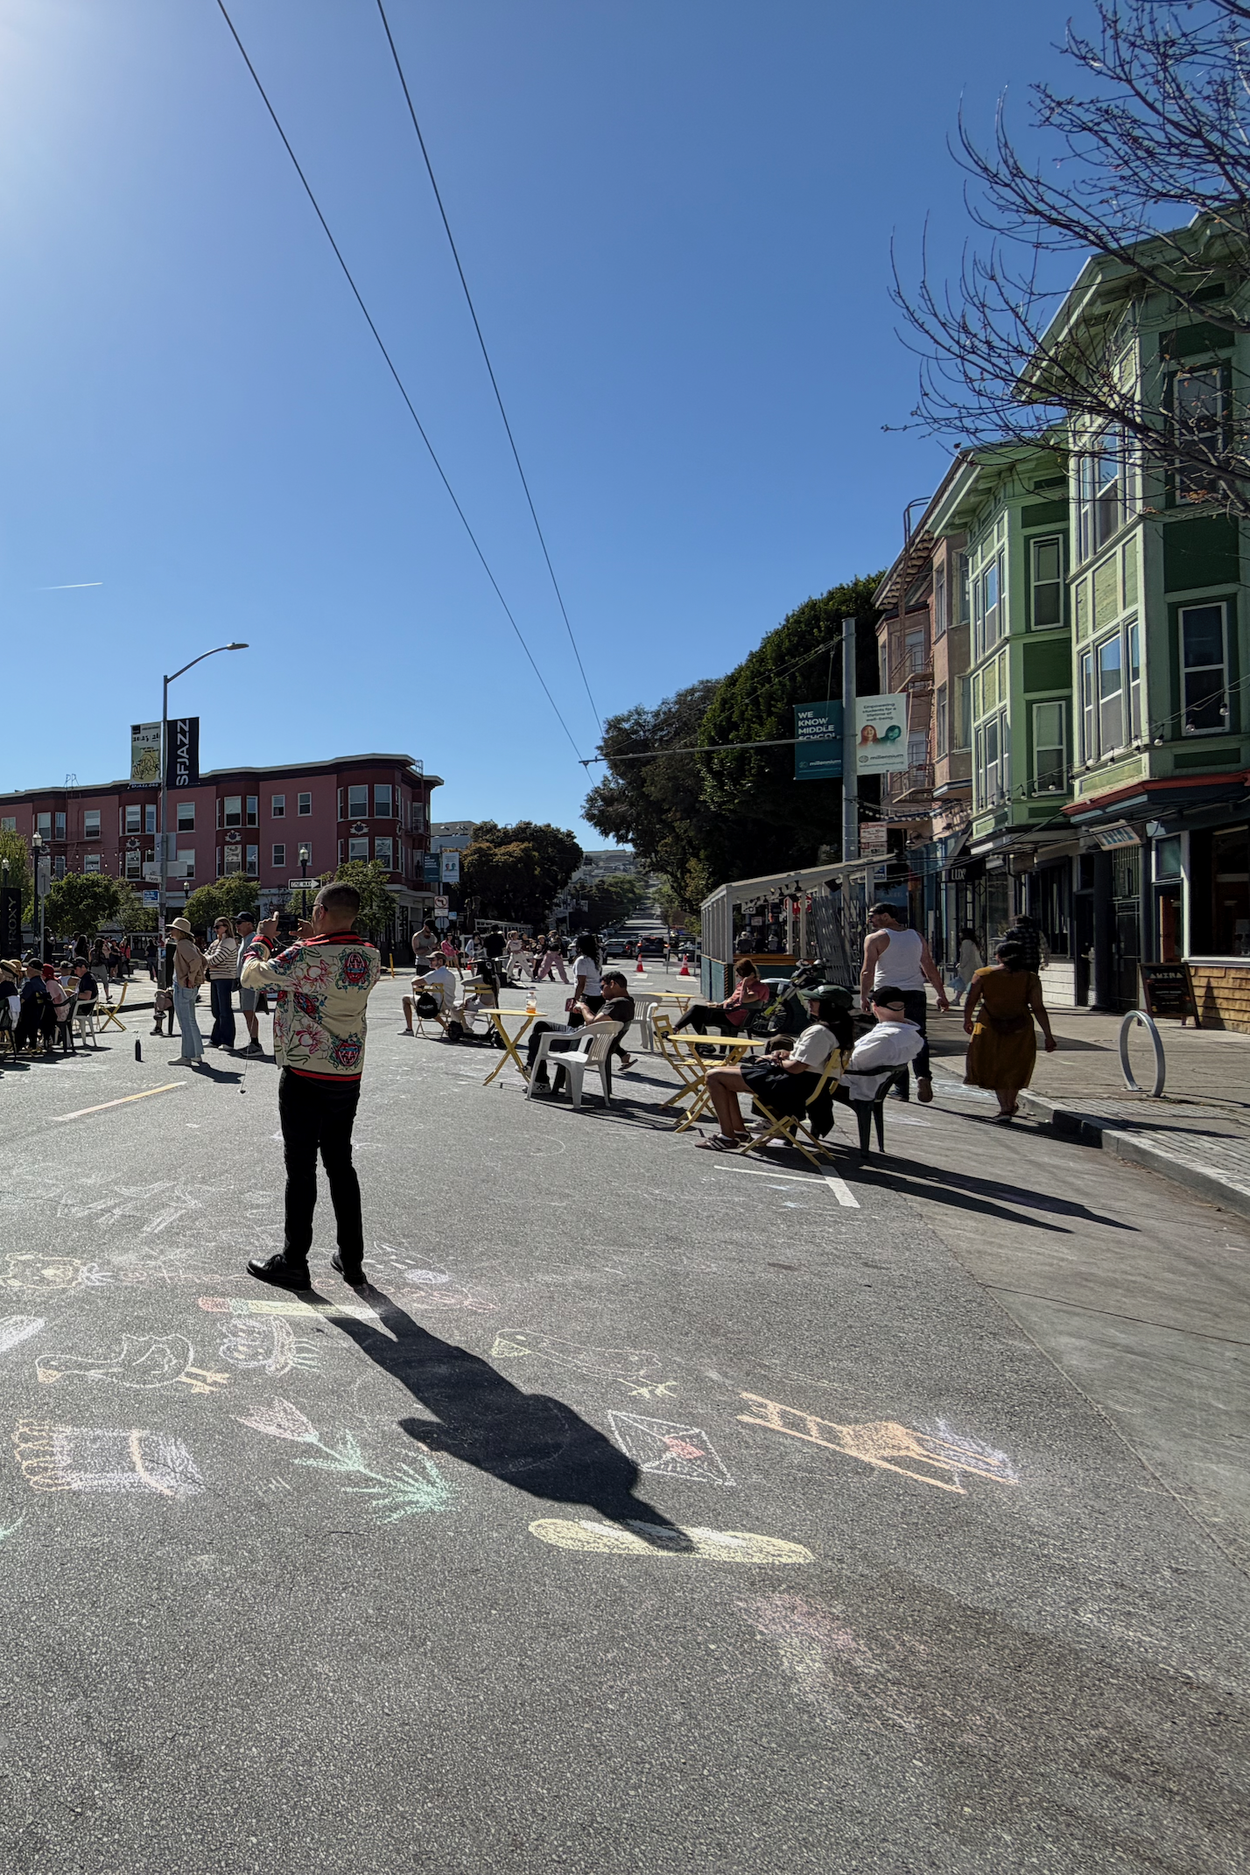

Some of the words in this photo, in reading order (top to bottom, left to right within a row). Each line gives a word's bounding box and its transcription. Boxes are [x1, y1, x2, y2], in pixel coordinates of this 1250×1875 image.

[798, 718, 828, 726] KNOW
[798, 725, 834, 734] MIDDLE
[176, 720, 189, 786] SFJAZZ
